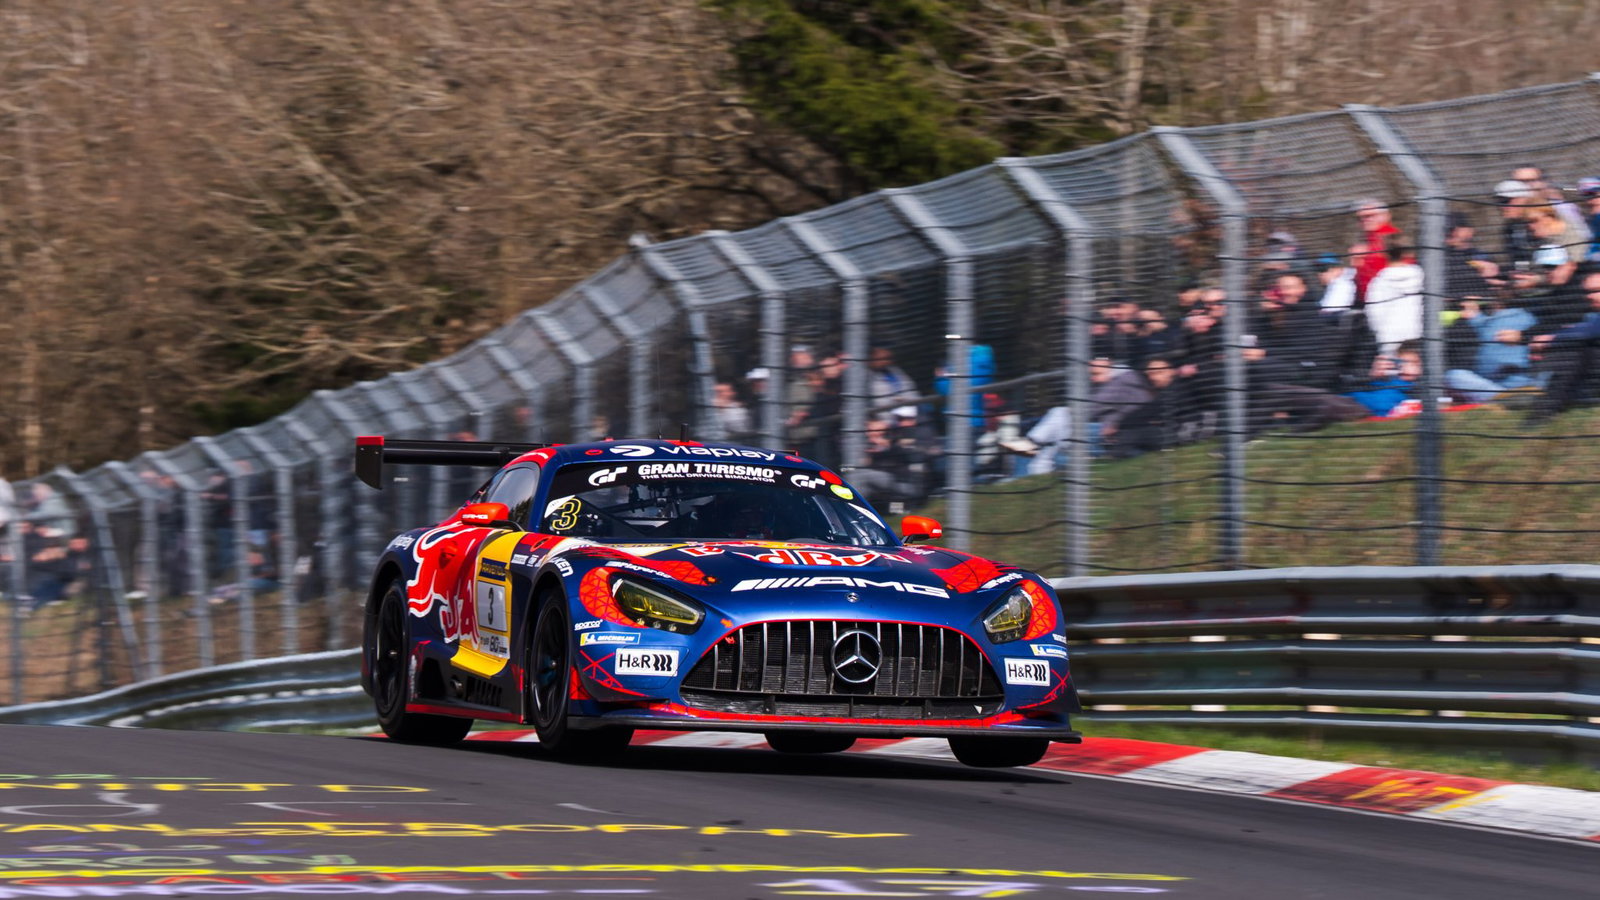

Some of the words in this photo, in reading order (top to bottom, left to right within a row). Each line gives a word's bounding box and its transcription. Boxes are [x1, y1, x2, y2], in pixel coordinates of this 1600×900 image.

[659, 446, 776, 461] viaplay
[638, 463, 689, 475] GRAN
[724, 474, 776, 483] SIMULATOR
[552, 498, 582, 531] 3
[803, 576, 951, 599] AMG
[487, 587, 495, 625] 3
[618, 653, 651, 669] H&R
[1007, 663, 1032, 678] H&R
